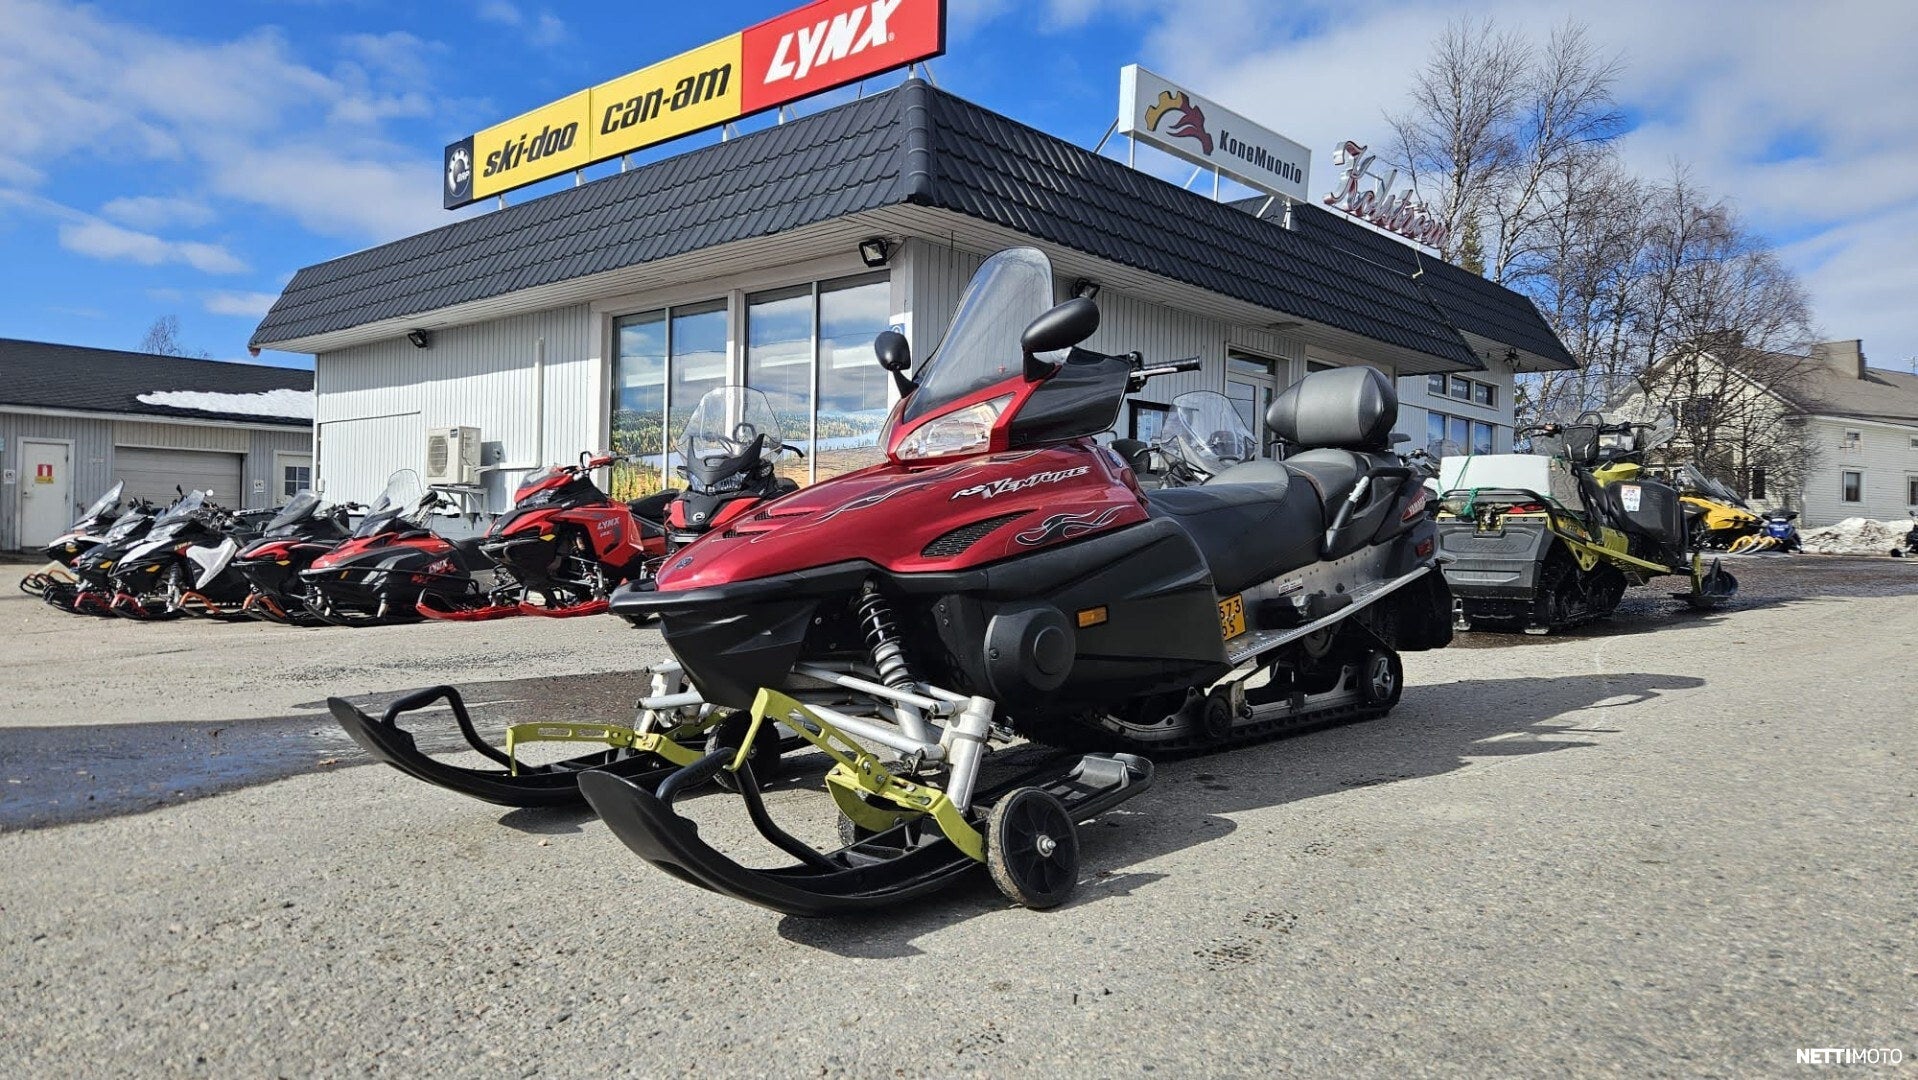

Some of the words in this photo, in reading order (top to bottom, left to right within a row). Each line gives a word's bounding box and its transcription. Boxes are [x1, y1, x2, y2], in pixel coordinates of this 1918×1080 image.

[763, 0, 903, 85] LYNX
[600, 62, 732, 136] can-am
[482, 121, 580, 178] ski-doo
[1219, 129, 1303, 185] KoneMuonio
